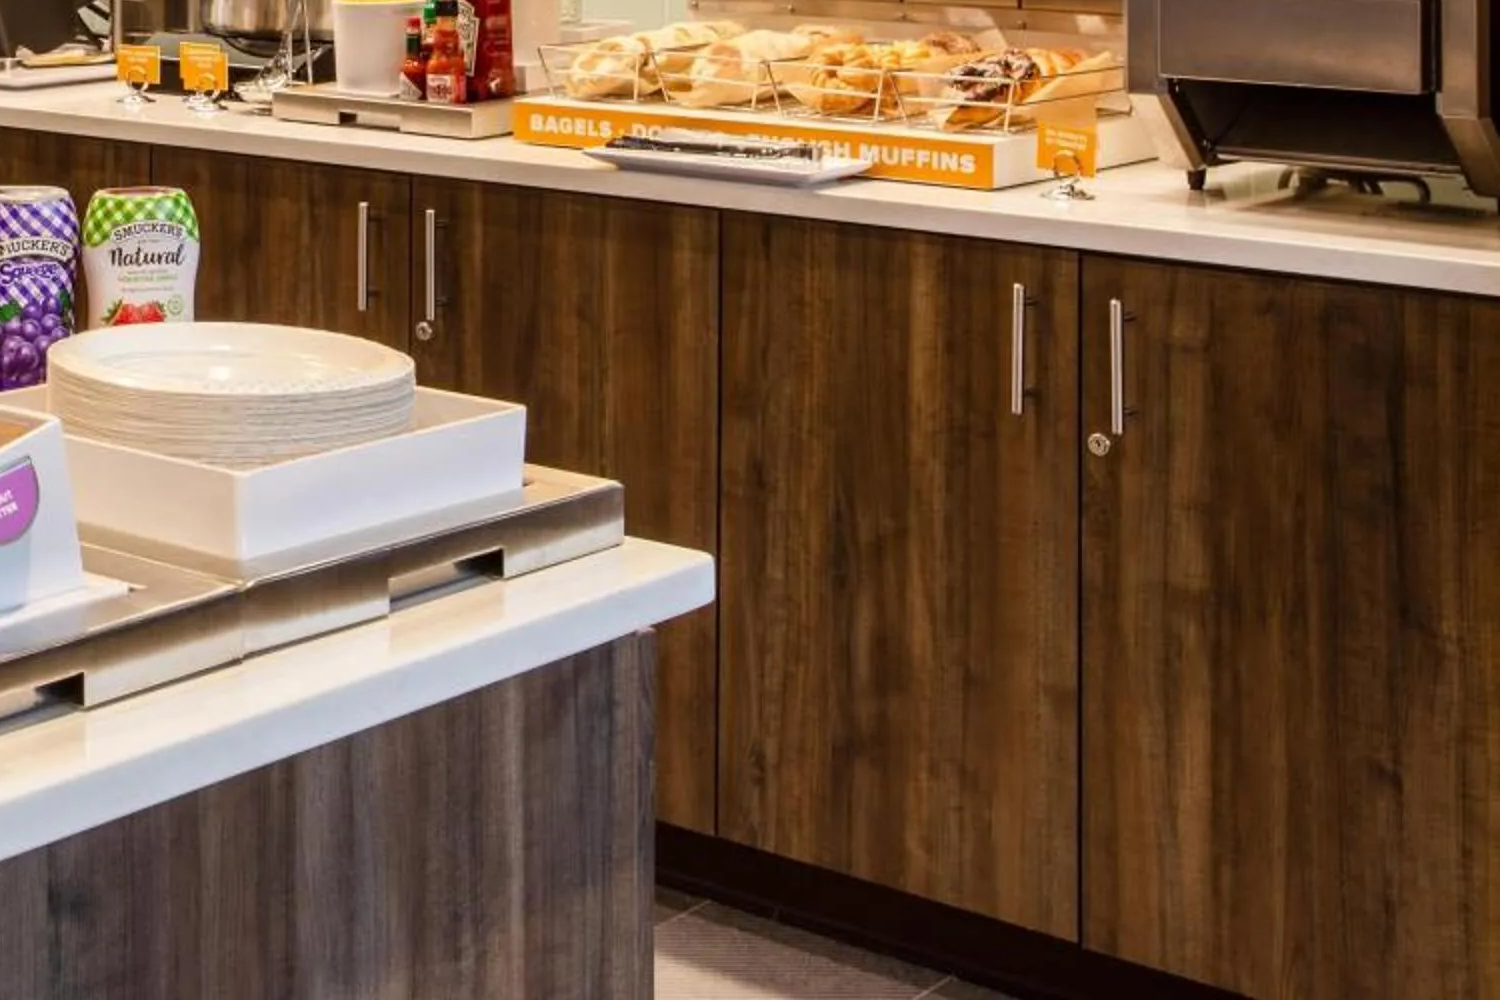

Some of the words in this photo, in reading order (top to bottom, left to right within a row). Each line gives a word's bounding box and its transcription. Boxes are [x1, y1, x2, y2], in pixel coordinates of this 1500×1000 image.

[530, 113, 613, 139] BAGELS
[859, 142, 977, 174] MUFFINS
[109, 242, 187, 268] Natural
